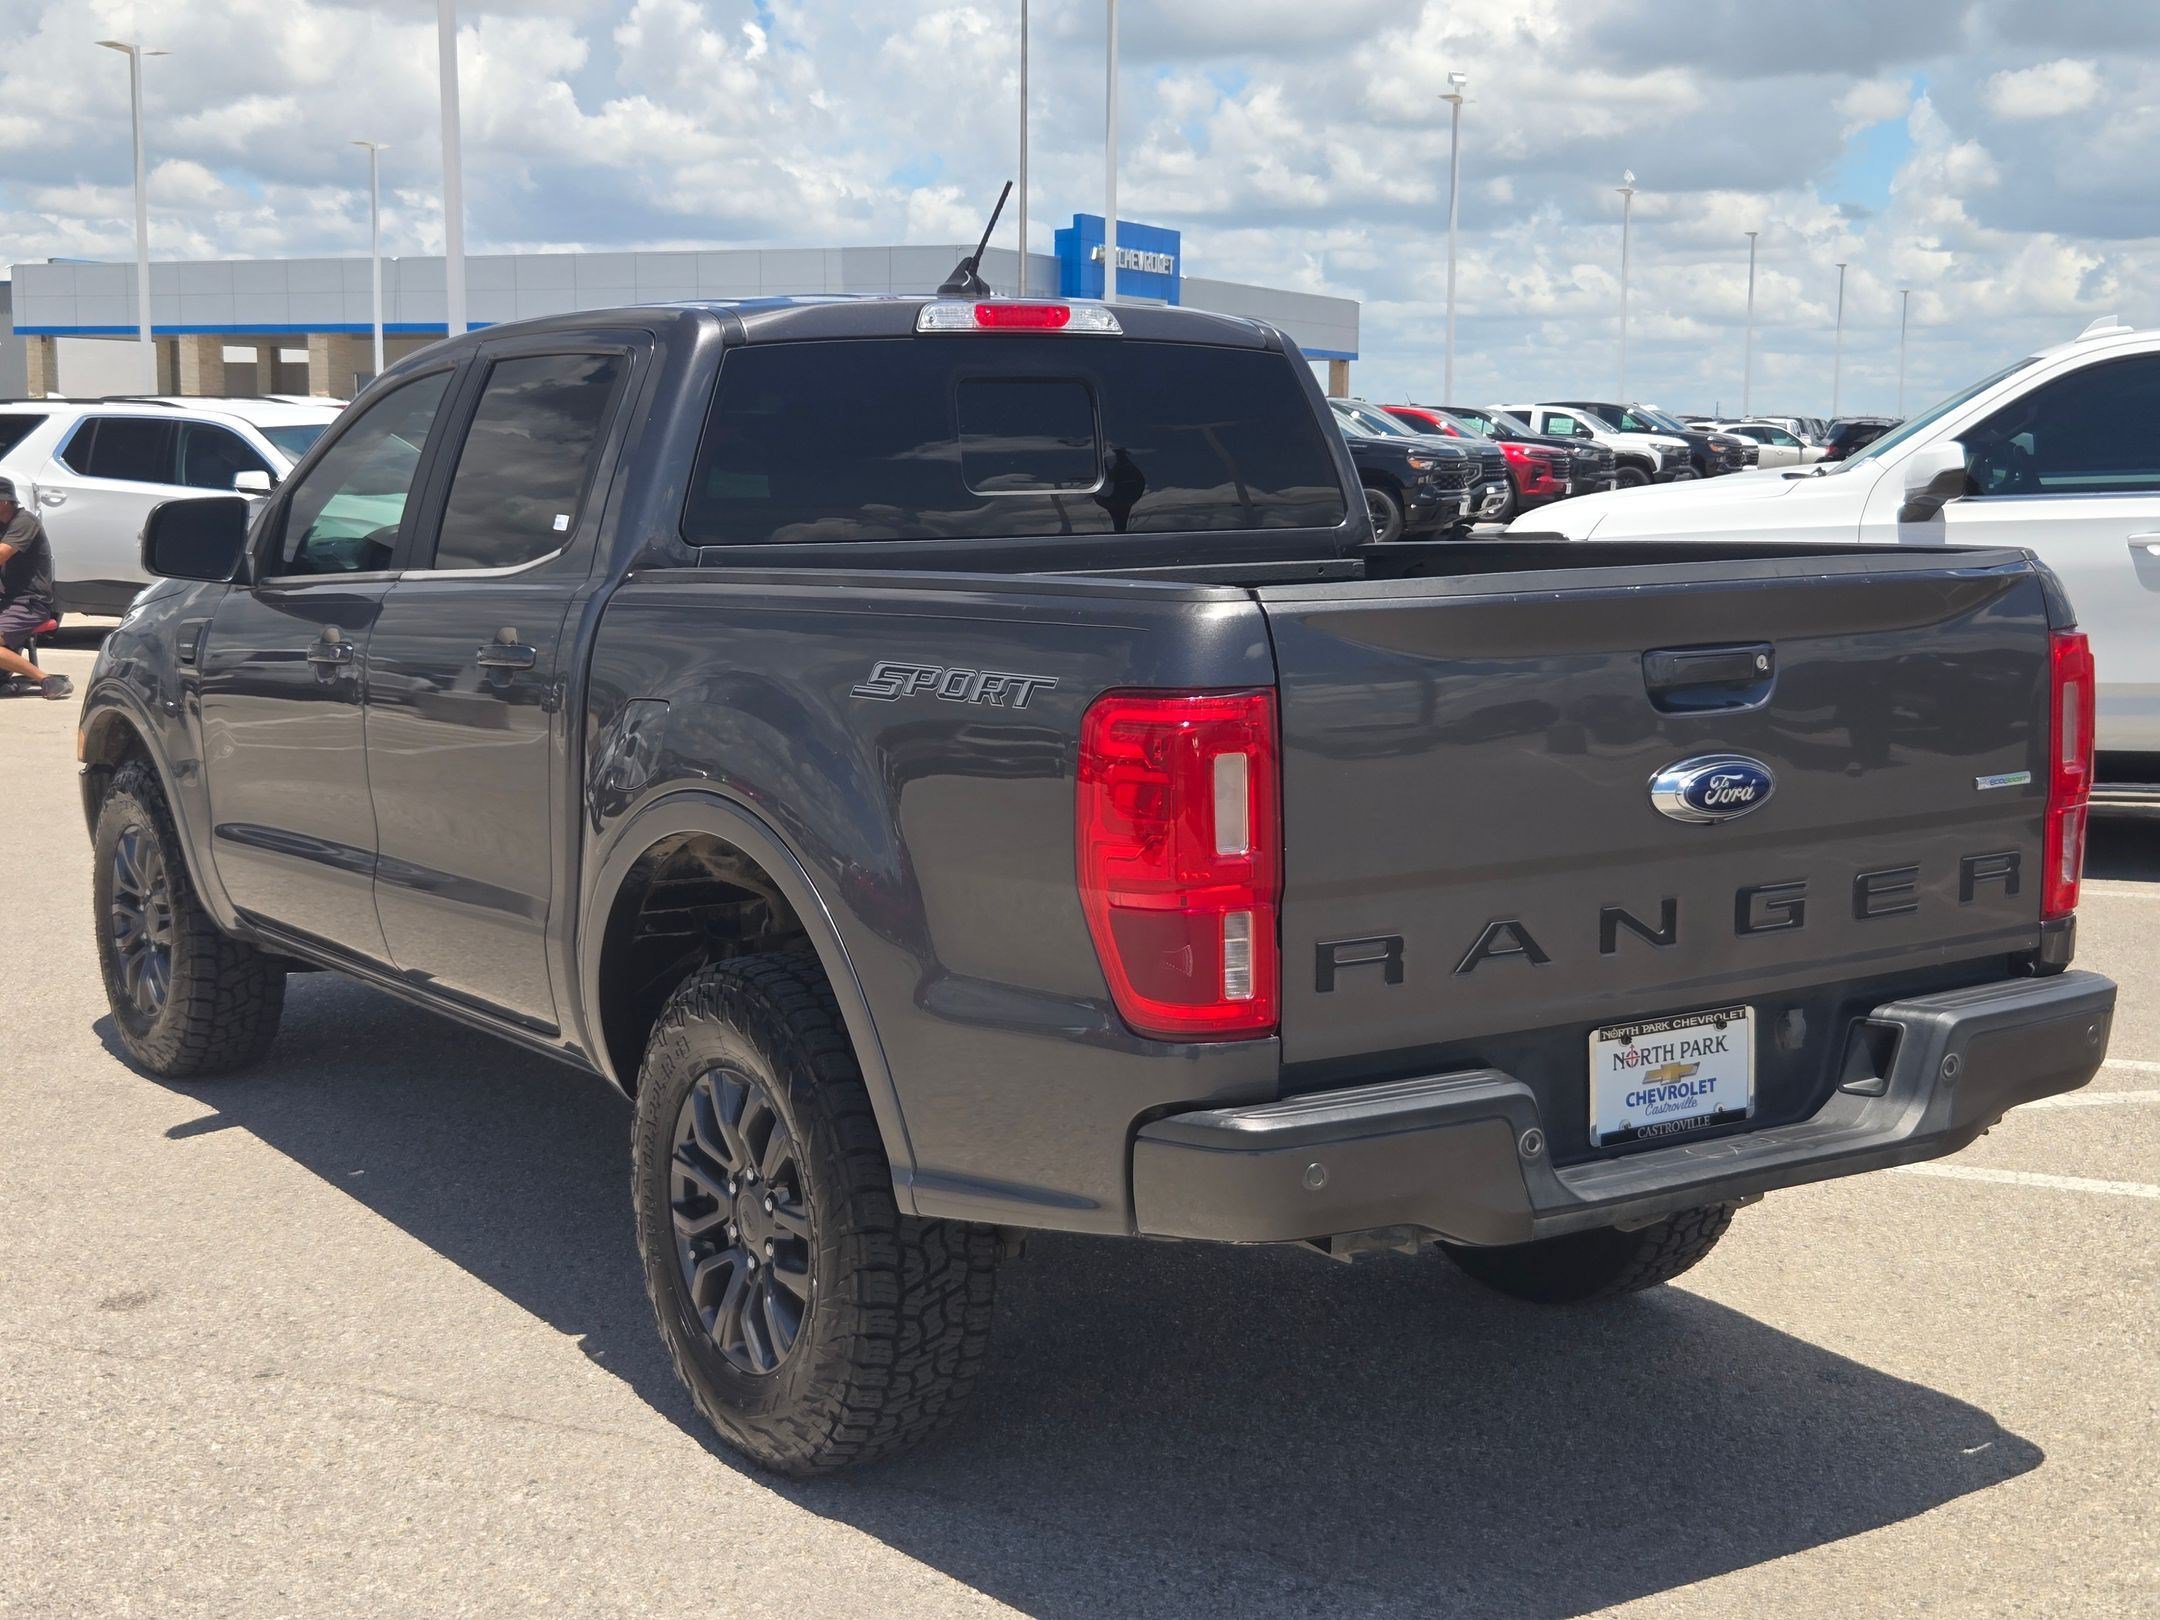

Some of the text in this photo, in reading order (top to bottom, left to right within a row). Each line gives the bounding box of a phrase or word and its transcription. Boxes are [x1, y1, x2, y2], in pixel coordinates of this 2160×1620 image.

[1116, 246, 1174, 275] CHEVROLET
[850, 660, 1059, 710] SPORT
[1704, 773, 1756, 805] Ford
[1314, 850, 2021, 993] RANGER
[1600, 1009, 1745, 1041] NORTH PARK CHEVROLET
[1612, 1035, 1729, 1071] NORTH PARK
[1625, 1077, 1717, 1108] CHEVROLET
[1644, 1096, 1698, 1117] Castroville
[1637, 1115, 1711, 1138] CASTROVILLE
